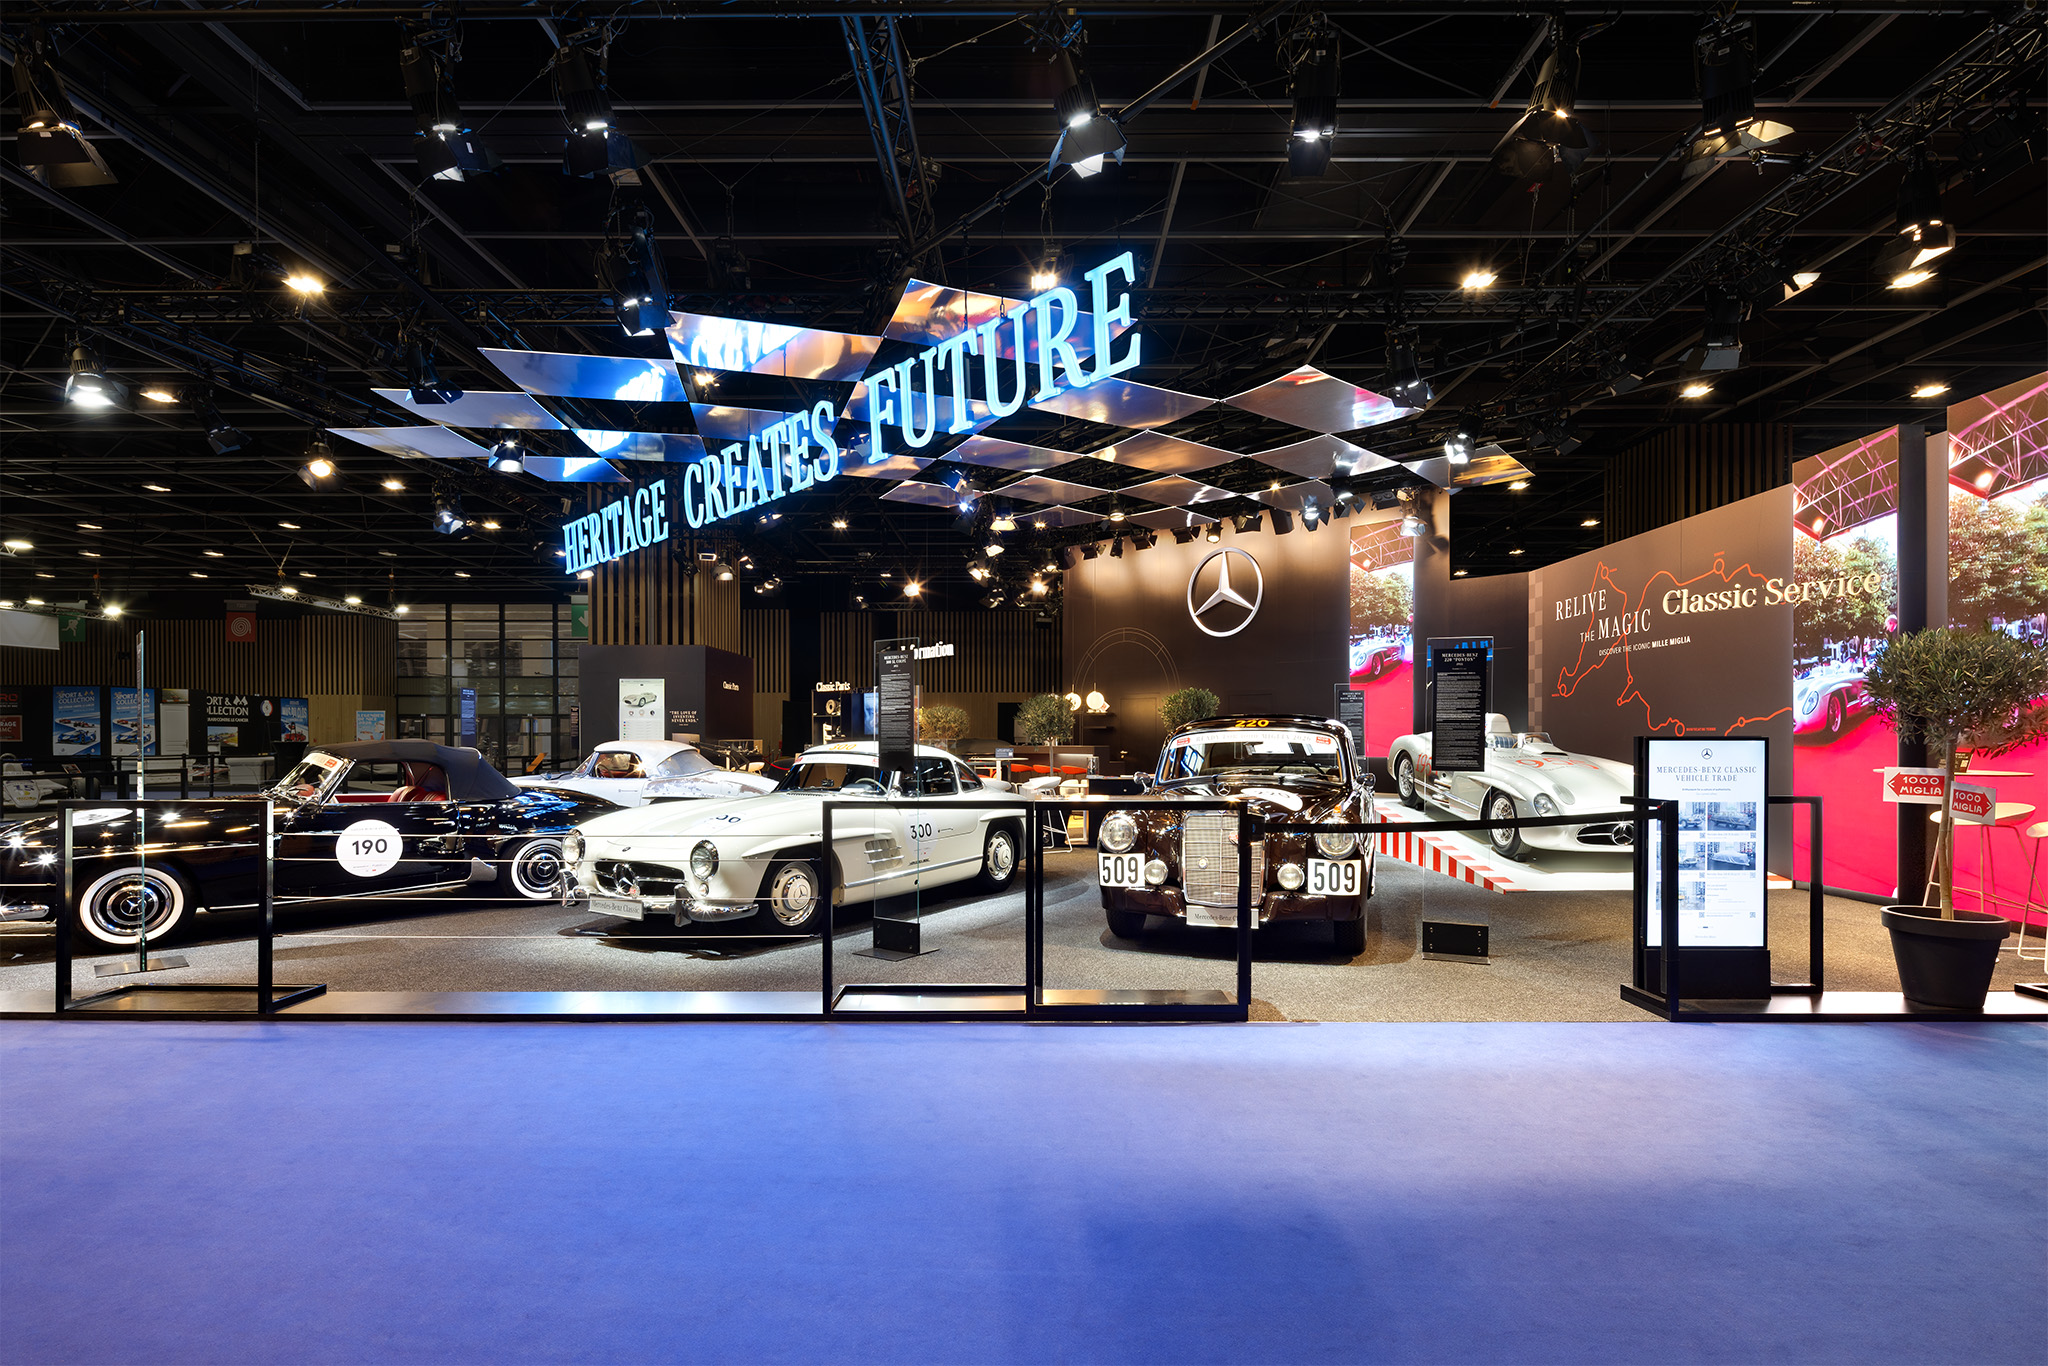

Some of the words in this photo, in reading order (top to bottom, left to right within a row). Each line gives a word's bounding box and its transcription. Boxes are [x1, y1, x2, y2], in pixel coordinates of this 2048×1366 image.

[562, 479, 669, 575] HERITAGE
[684, 400, 839, 529] CREATES
[864, 251, 1141, 464] FUTURE
[1662, 583, 1758, 616] Classic
[1764, 571, 1882, 606] Service
[1555, 588, 1607, 622] RELIVE
[1580, 630, 1595, 642] THE
[1598, 608, 1651, 640] MAGIC
[1598, 646, 1622, 656] DISCOVER
[1622, 644, 1632, 653] THE
[1632, 642, 1650, 651] ICONIC
[1652, 638, 1668, 649] MILLE
[1669, 636, 1691, 646] MIGLIA
[816, 682, 835, 692] Classic
[835, 681, 850, 691] Parts
[224, 696, 232, 706] &
[206, 706, 249, 716] LLECTION
[1235, 720, 1270, 728] 220
[1900, 786, 1942, 795] MIGLIA
[1955, 792, 1981, 803] 1000
[1952, 802, 1983, 813] MIGLIA
[910, 823, 932, 839] 300
[352, 839, 387, 855] 190
[1102, 856, 1139, 884] 509
[1314, 862, 1355, 892] 509
[623, 904, 640, 913] Classic
